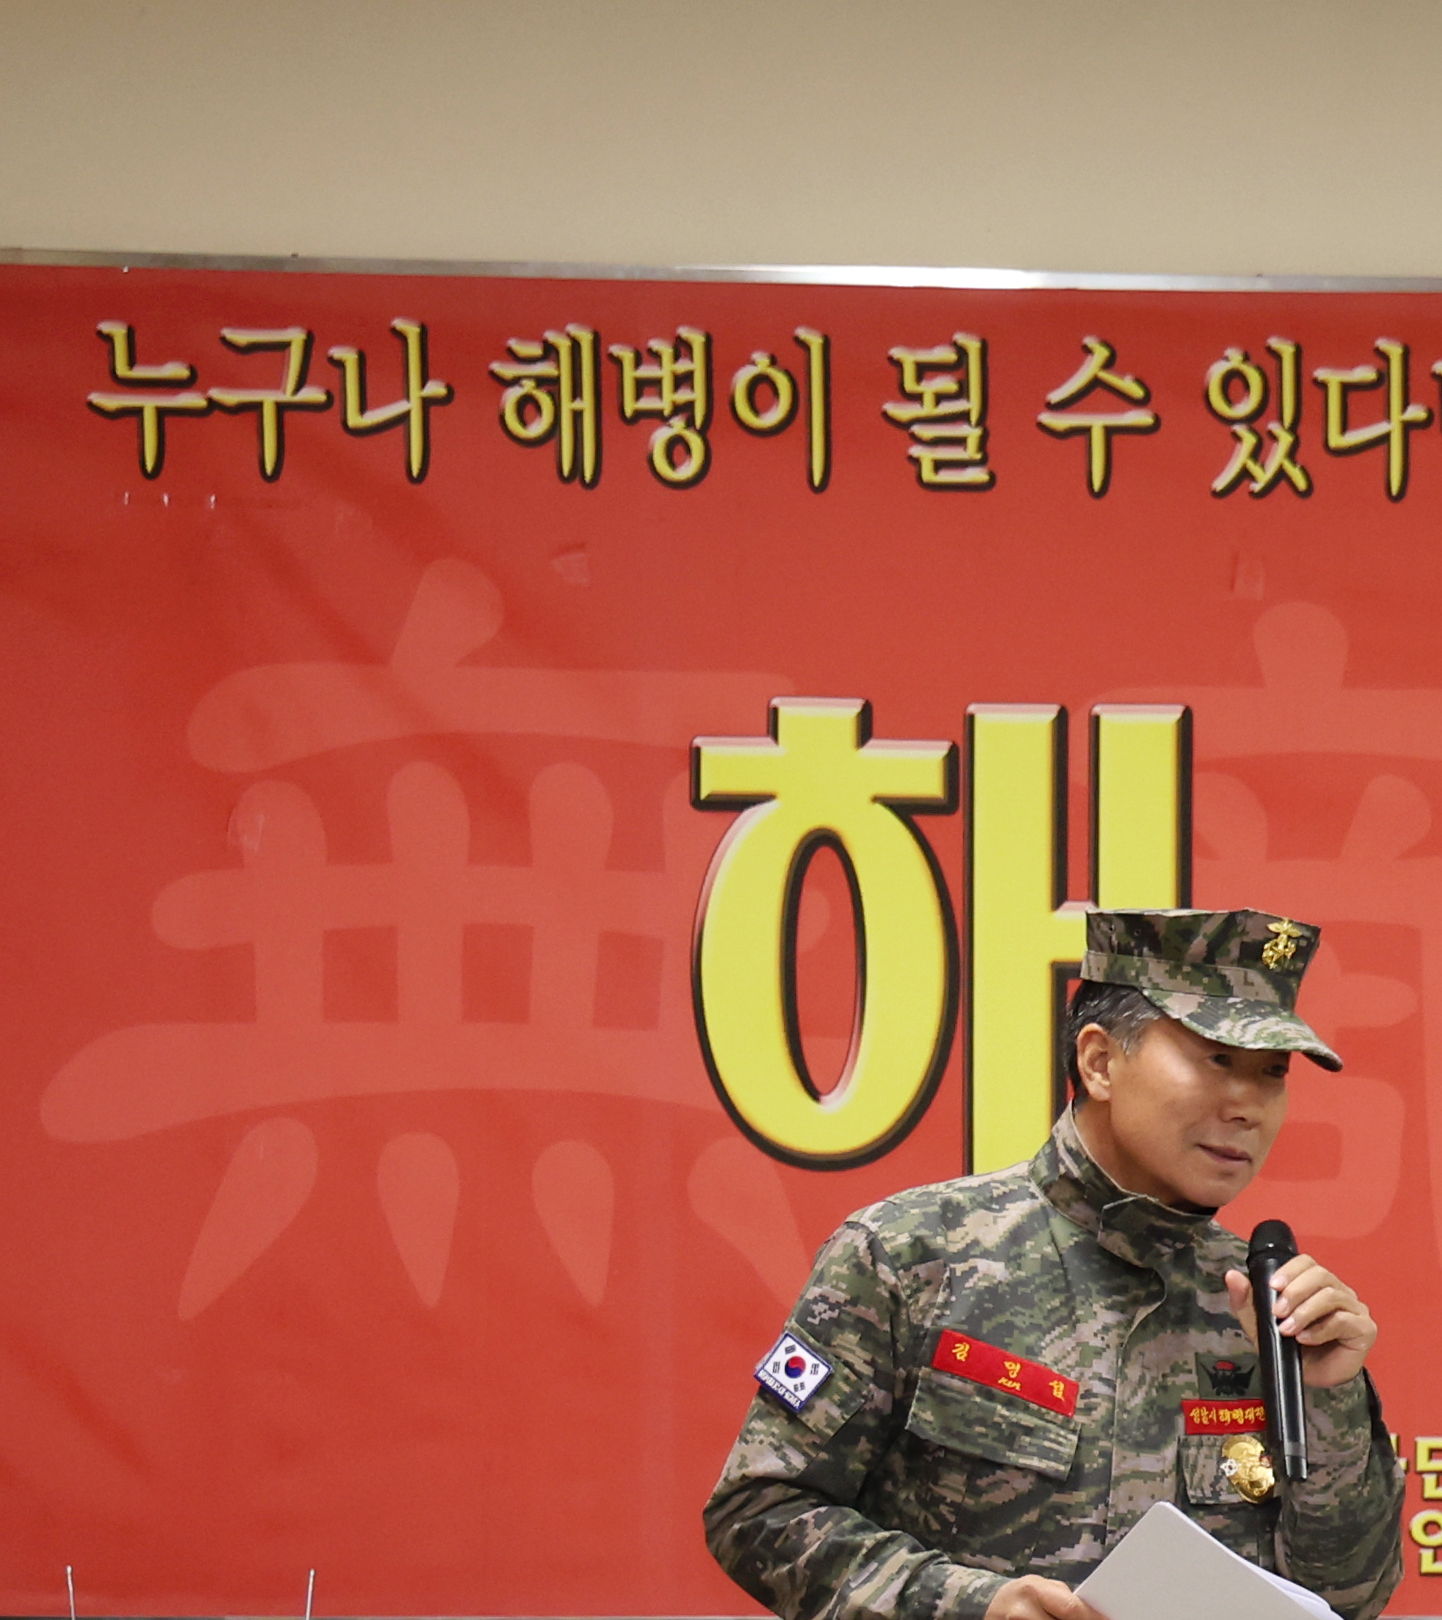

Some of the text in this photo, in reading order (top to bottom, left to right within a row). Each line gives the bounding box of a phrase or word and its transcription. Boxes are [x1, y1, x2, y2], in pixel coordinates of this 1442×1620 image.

[87, 318, 450, 480] 누구나
[489, 321, 829, 490] 해병이
[881, 332, 994, 488] 될
[1037, 335, 1159, 495] 수
[690, 694, 1194, 1175] 해
